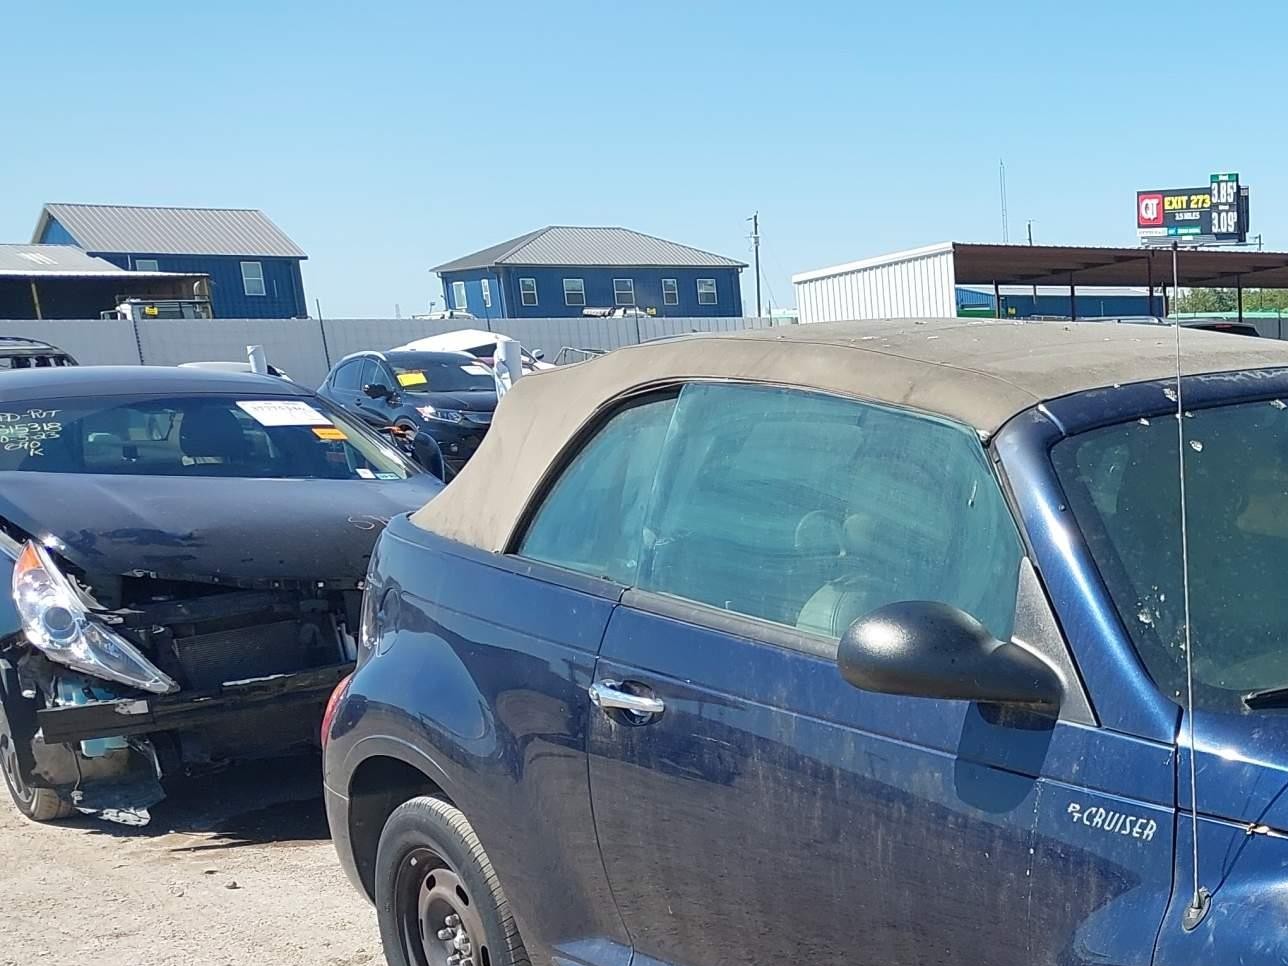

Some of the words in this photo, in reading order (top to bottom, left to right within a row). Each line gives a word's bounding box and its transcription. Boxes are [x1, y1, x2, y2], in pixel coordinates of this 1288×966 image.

[1141, 198, 1159, 221] QT
[1164, 196, 1189, 210] EXIT
[1190, 194, 1211, 208] 273
[1082, 806, 1157, 841] CRUISER
